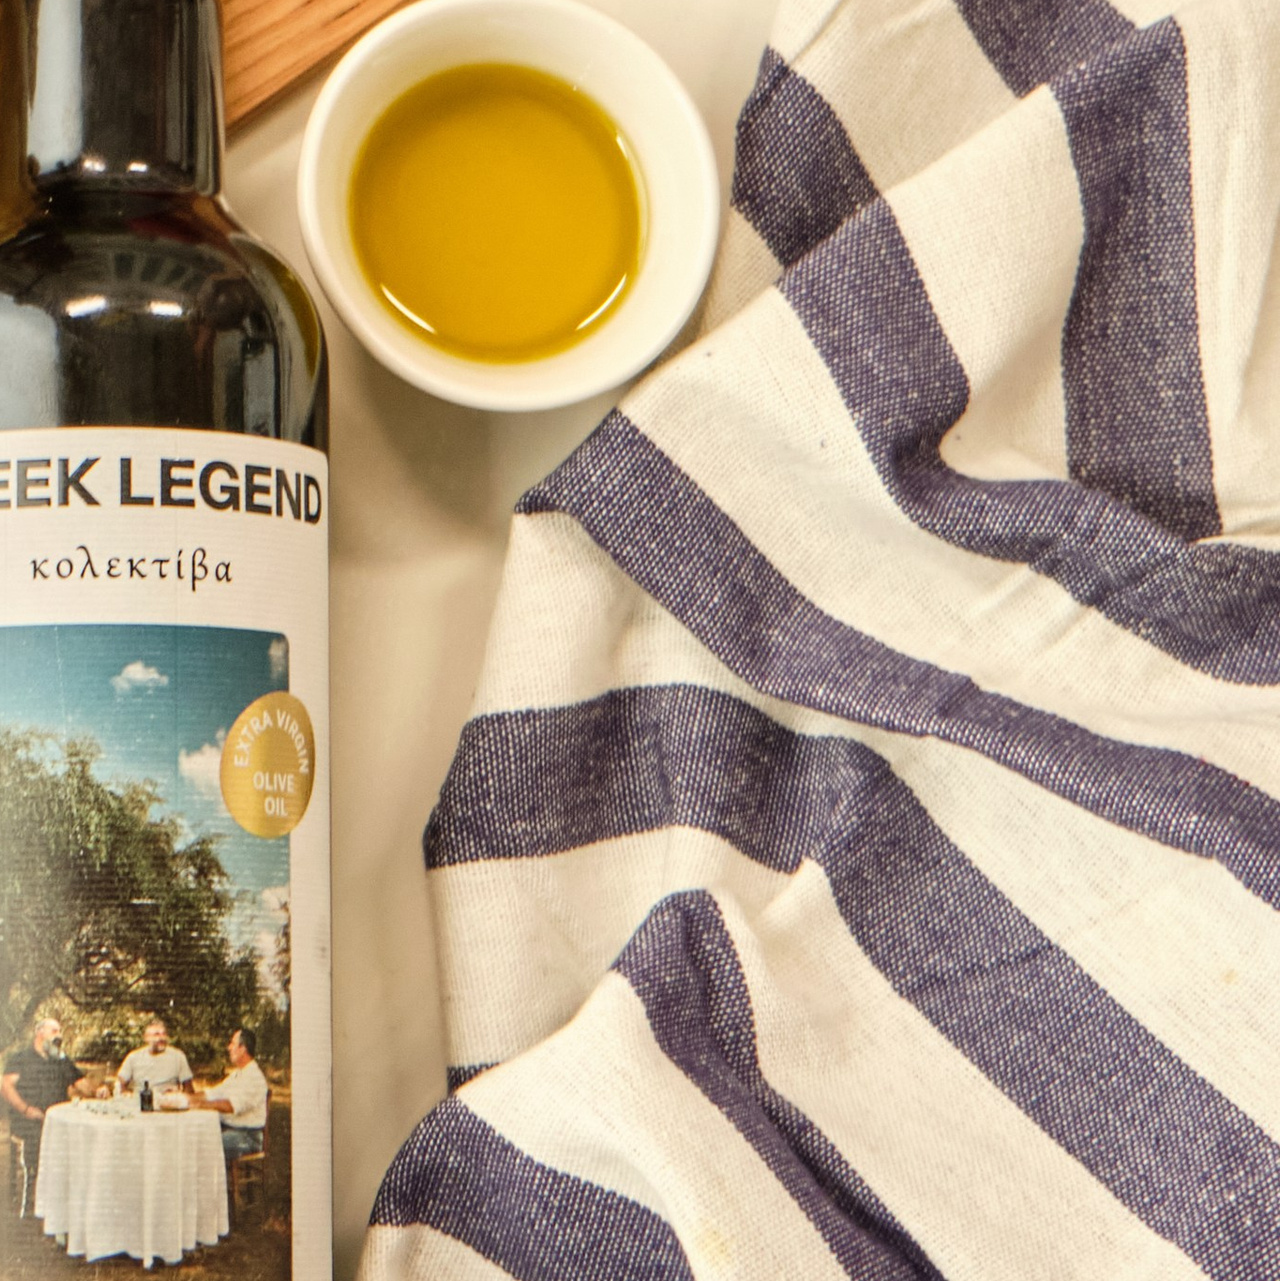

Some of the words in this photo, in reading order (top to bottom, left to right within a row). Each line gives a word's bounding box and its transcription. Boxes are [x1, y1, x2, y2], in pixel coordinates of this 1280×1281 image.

[120, 457, 322, 525] LEGEND
[32, 545, 233, 592] κολεκτίβα
[234, 710, 273, 768] EXTRA
[276, 709, 309, 774] VIRGIN
[253, 772, 294, 794] OLIVE
[265, 797, 288, 817] OIL
